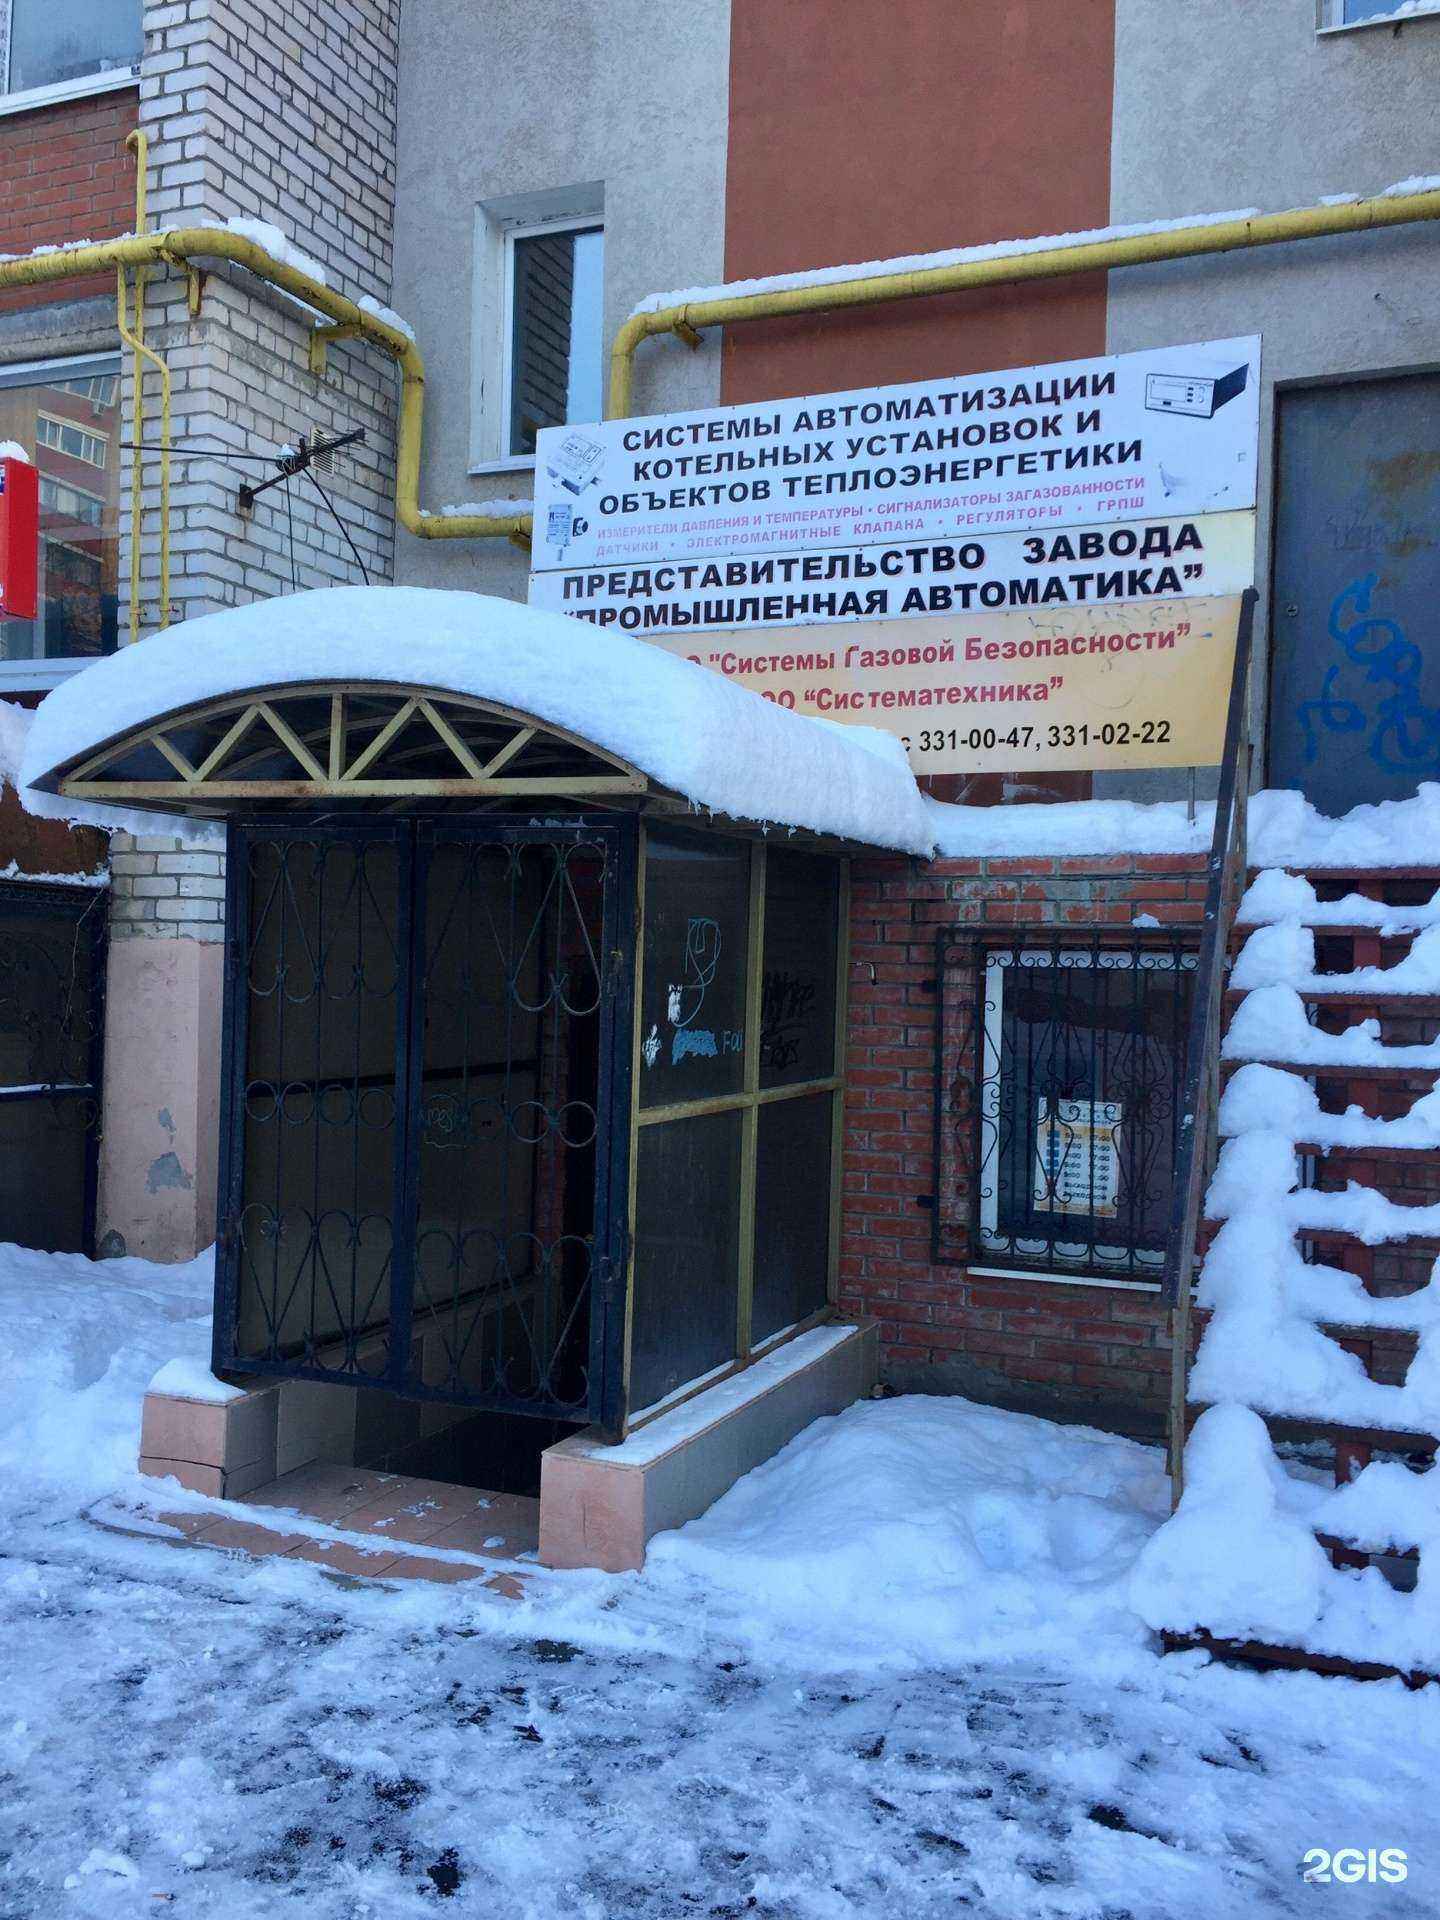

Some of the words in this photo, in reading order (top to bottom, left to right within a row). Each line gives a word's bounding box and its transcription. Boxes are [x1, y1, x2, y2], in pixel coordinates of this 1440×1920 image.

[623, 415, 781, 451] СИСТЕМЫ
[793, 371, 1116, 432] АВТОМАТИЗАЦИИ
[599, 480, 771, 515] ОБЪЕКТОВ
[783, 439, 1142, 498] ТЕПЛОЭНЕРГЕТИКИ
[634, 441, 834, 482] КОТЕЛЬНЫХ
[847, 414, 1063, 460] УСТАНОВОК
[1077, 409, 1101, 434] И
[596, 541, 659, 557] ДАТЧИКИ
[687, 526, 841, 548] ЭЛЕКТРОМАГНИТНЫЕ
[853, 518, 924, 535] КЛАПАНА
[956, 505, 1063, 526] РЕГУЛЯТОРЫ
[1097, 496, 1144, 512] ГРПШ
[598, 524, 678, 540] ИЗМЕРИТЕЛИ
[681, 516, 749, 534] ДАВЛЕНИЯ
[753, 515, 762, 526] И
[765, 505, 863, 524] ТЕМПЕРАТУРЫ
[877, 493, 1001, 515] СИГНАЛИЗАТОРЫ
[1006, 477, 1145, 502] ЗАГАЗОВАННОСТИ
[563, 542, 986, 599] ПРЕДСТАВИТЕЛЬСТВО
[1023, 523, 1203, 564] ЗАВОДА
[901, 563, 1203, 612] АВТОМАТИКА”
[709, 650, 835, 675] "Системы
[844, 640, 955, 668] Газовой
[919, 726, 1041, 752] 331-00-47,
[1047, 720, 1171, 748] 331-02-22
